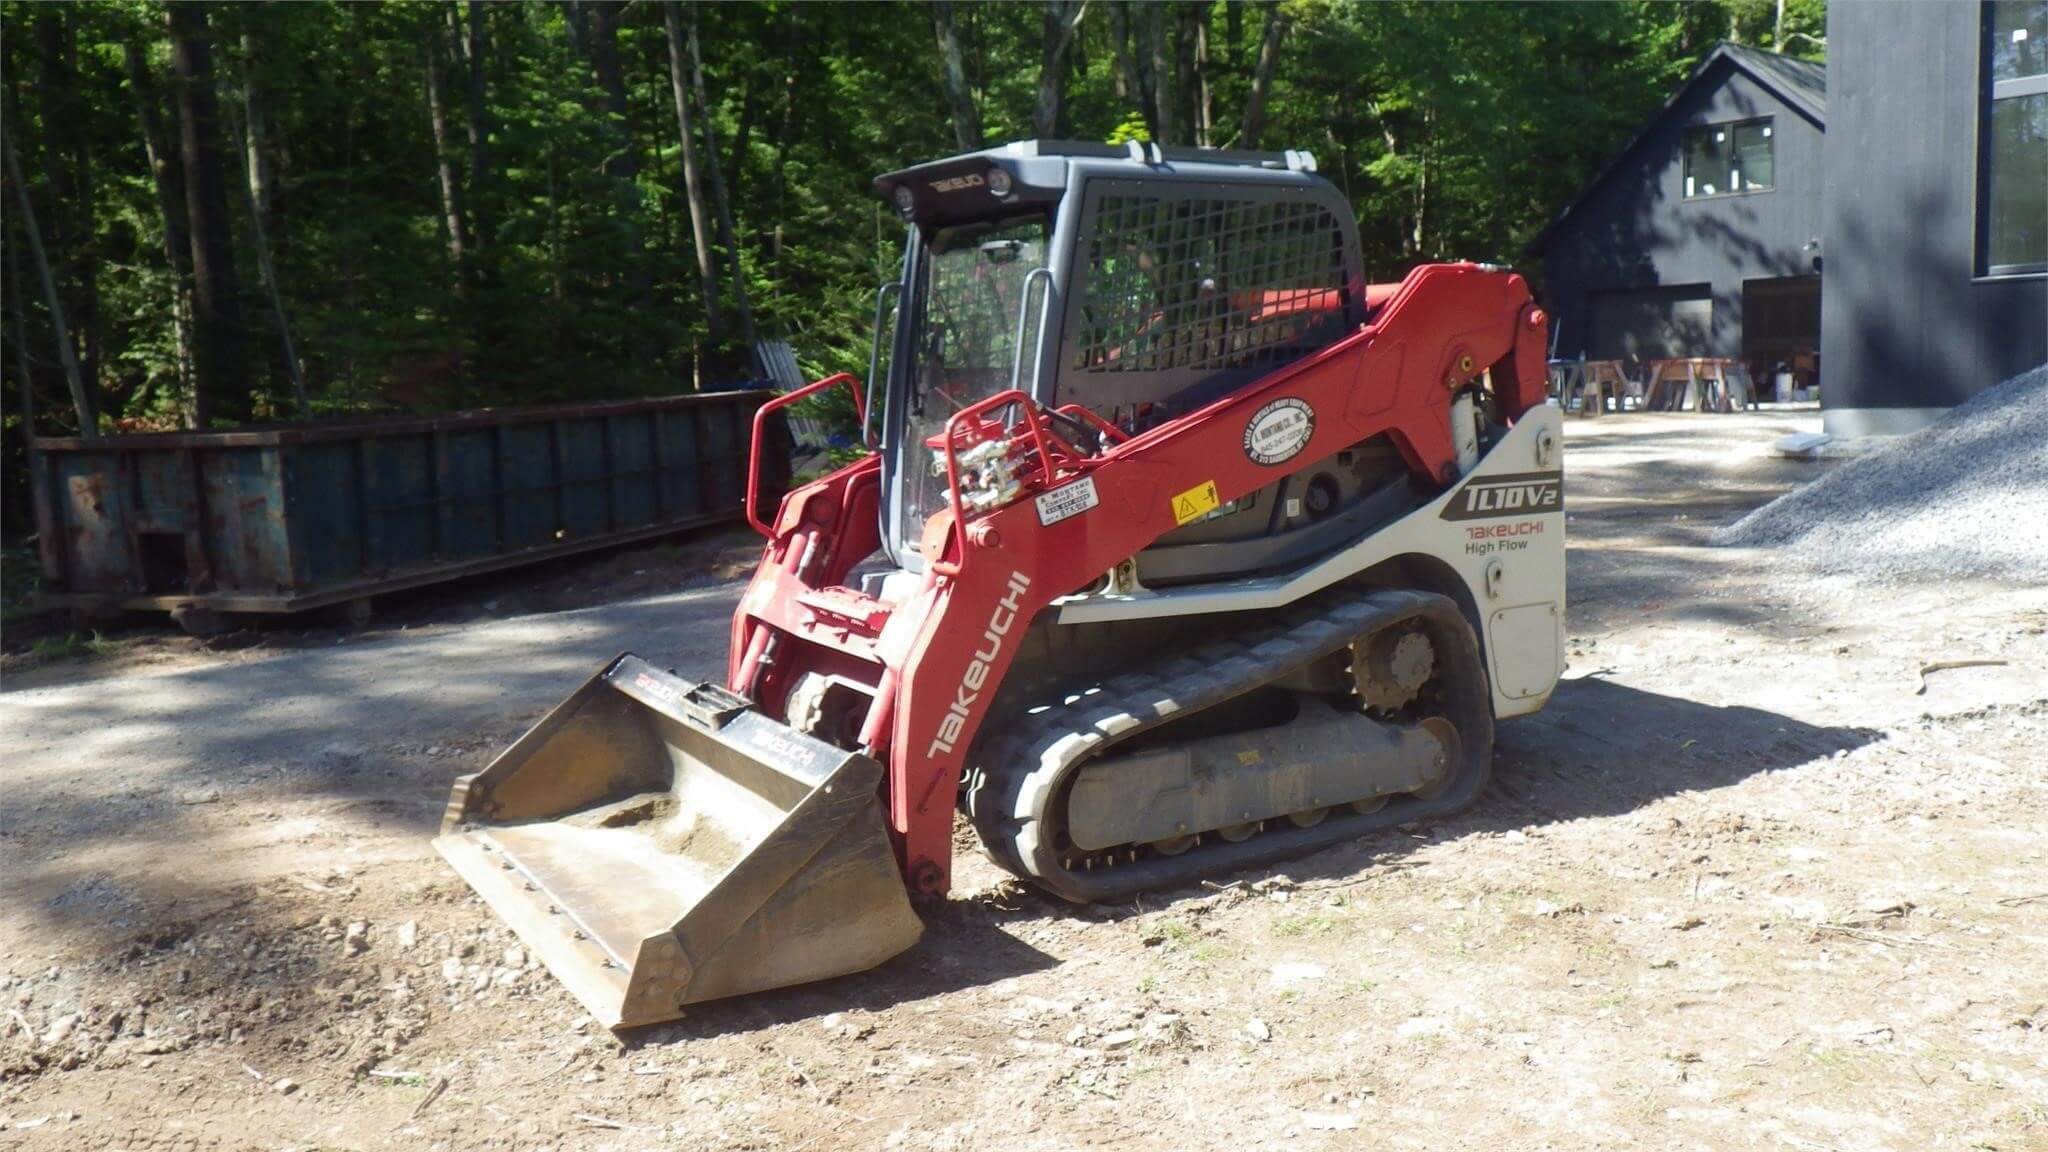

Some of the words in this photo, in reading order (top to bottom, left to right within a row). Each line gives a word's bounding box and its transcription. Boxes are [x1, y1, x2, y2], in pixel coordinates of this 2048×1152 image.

[1465, 521, 1544, 540] TAKEUCHI
[1465, 542, 1495, 556] High
[1499, 540, 1528, 552] Flow
[926, 570, 1031, 760] TAKEUCHI
